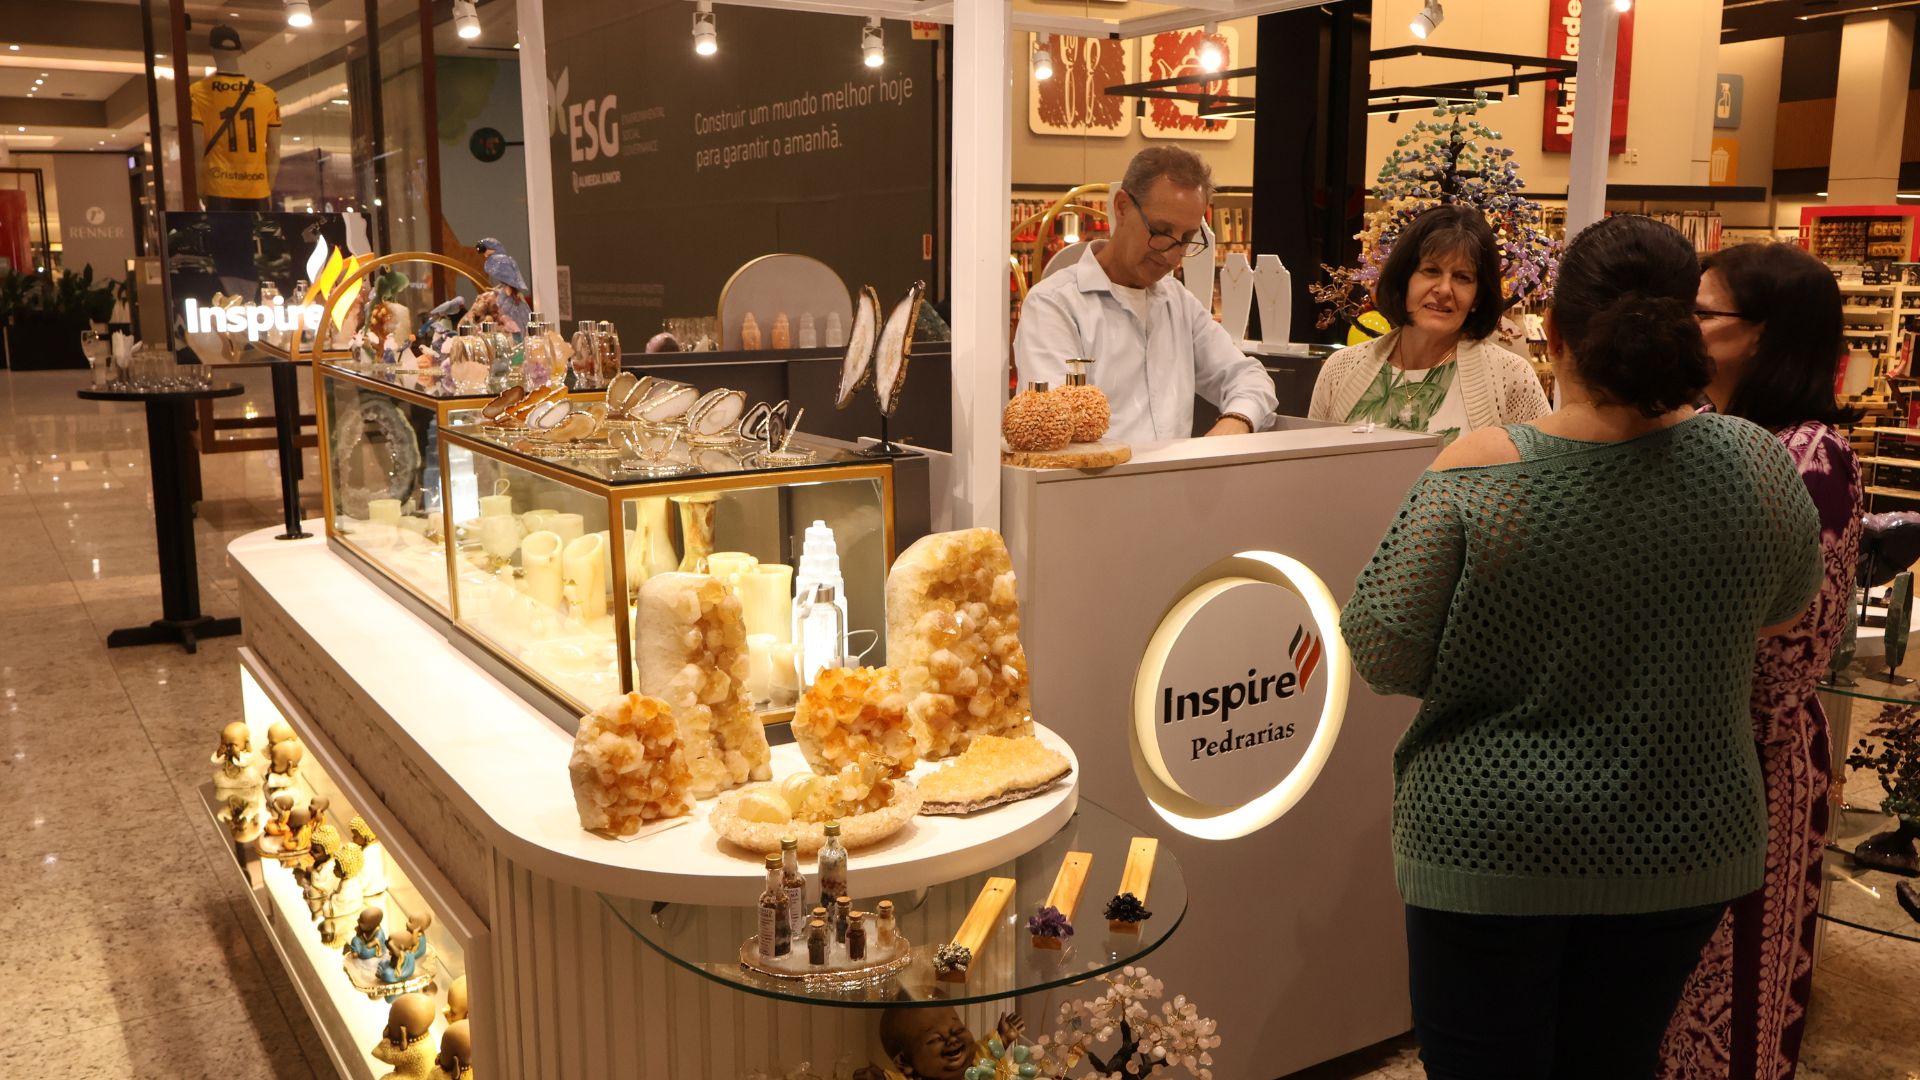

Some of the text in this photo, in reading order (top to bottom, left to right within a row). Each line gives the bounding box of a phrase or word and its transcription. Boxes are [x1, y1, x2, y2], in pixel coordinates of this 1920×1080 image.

[695, 72, 913, 135] Construir um mundo melhor hoje
[220, 107, 256, 153] 11
[569, 94, 619, 162] ESG
[696, 123, 842, 172] para garantir o amanhã.
[70, 227, 125, 239] RENNER
[185, 296, 325, 342] Inspire
[1163, 668, 1297, 724] Inspire
[1191, 722, 1295, 761] Pedrarias
